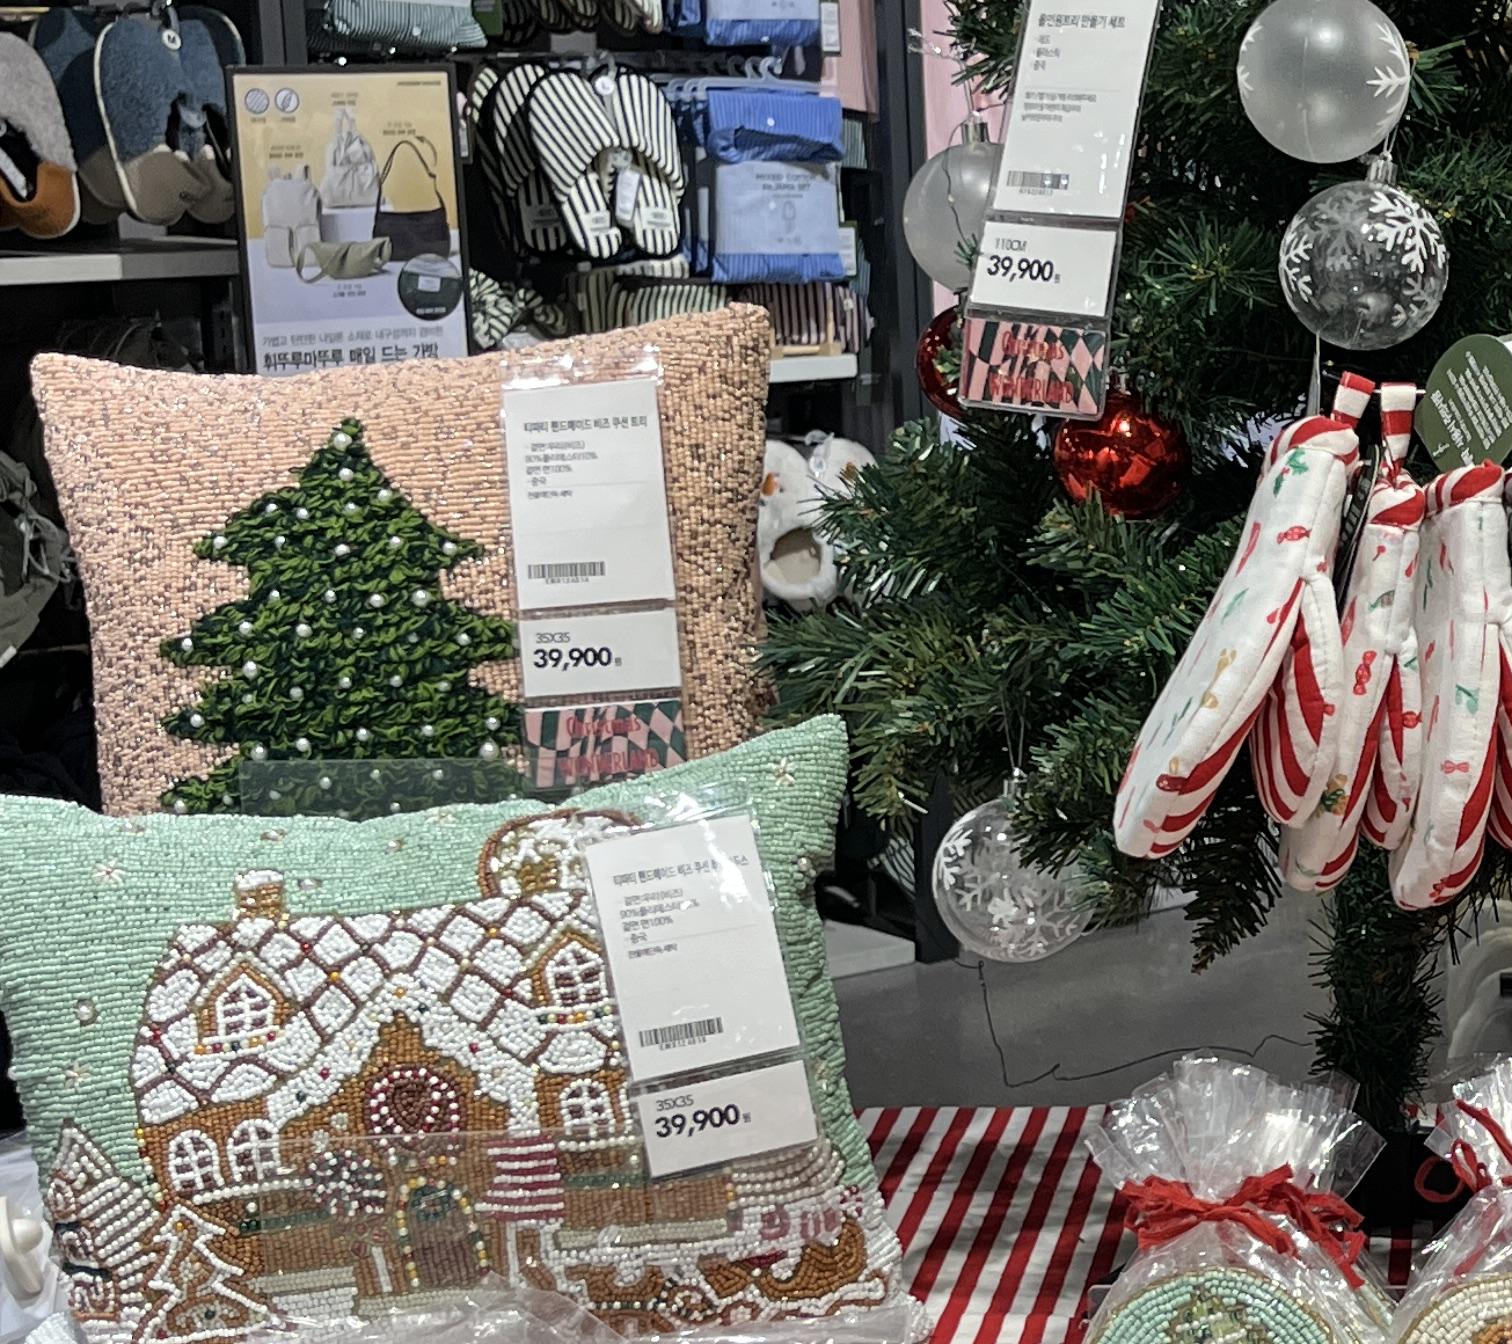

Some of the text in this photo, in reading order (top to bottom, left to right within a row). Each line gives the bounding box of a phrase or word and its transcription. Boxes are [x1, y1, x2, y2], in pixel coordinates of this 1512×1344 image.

[987, 254, 1054, 282] 39,900
[535, 632, 571, 644] 35X35
[533, 647, 612, 672] 39,900
[656, 1094, 695, 1112] 35X35
[655, 1103, 740, 1138] 39,900
